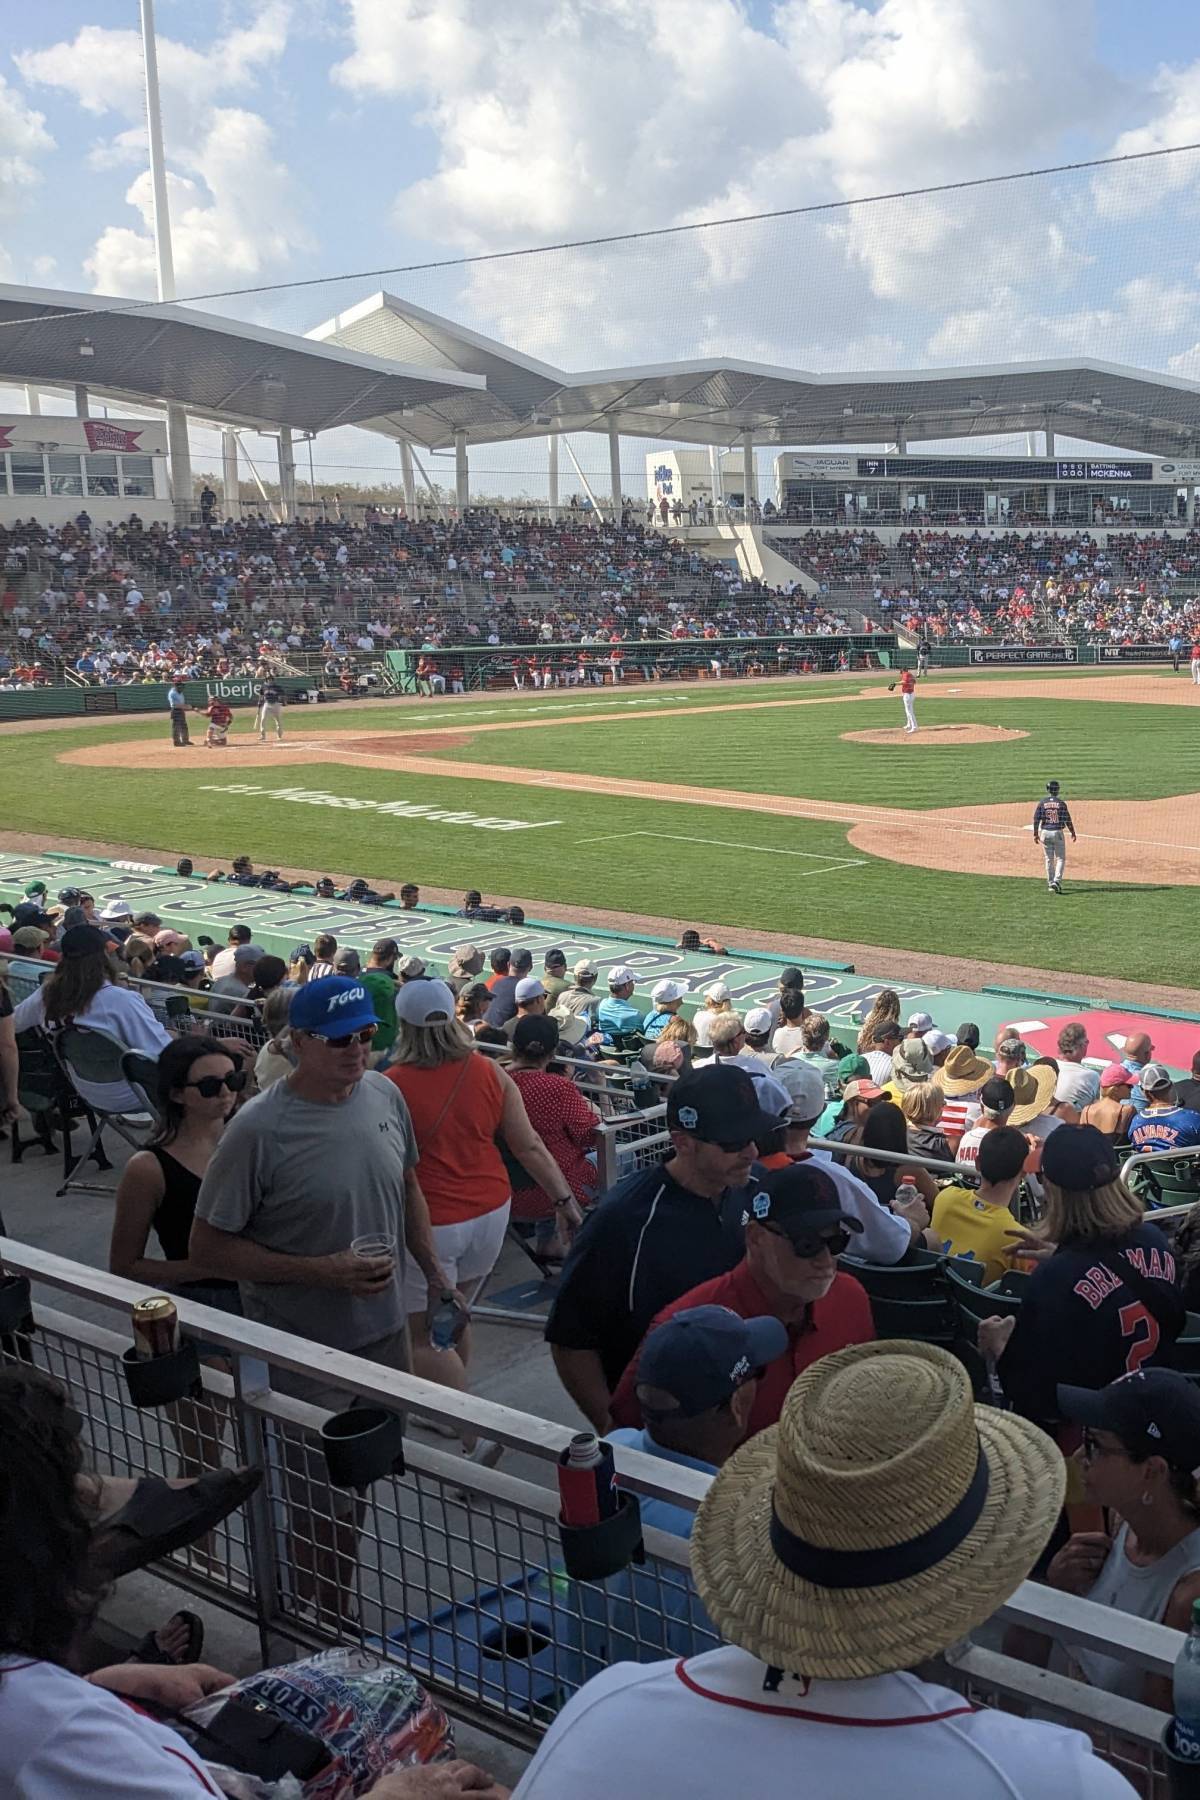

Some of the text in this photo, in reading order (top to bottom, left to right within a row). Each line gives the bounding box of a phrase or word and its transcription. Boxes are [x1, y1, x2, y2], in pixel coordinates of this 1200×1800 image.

[1090, 470, 1132, 478] MCKENNA
[986, 652, 1025, 660] PERFECT
[246, 787, 564, 831] MassMutual
[327, 987, 364, 1012] FGCU
[1133, 1124, 1179, 1145] ALVAREZ
[1073, 1247, 1176, 1310] BRMAN
